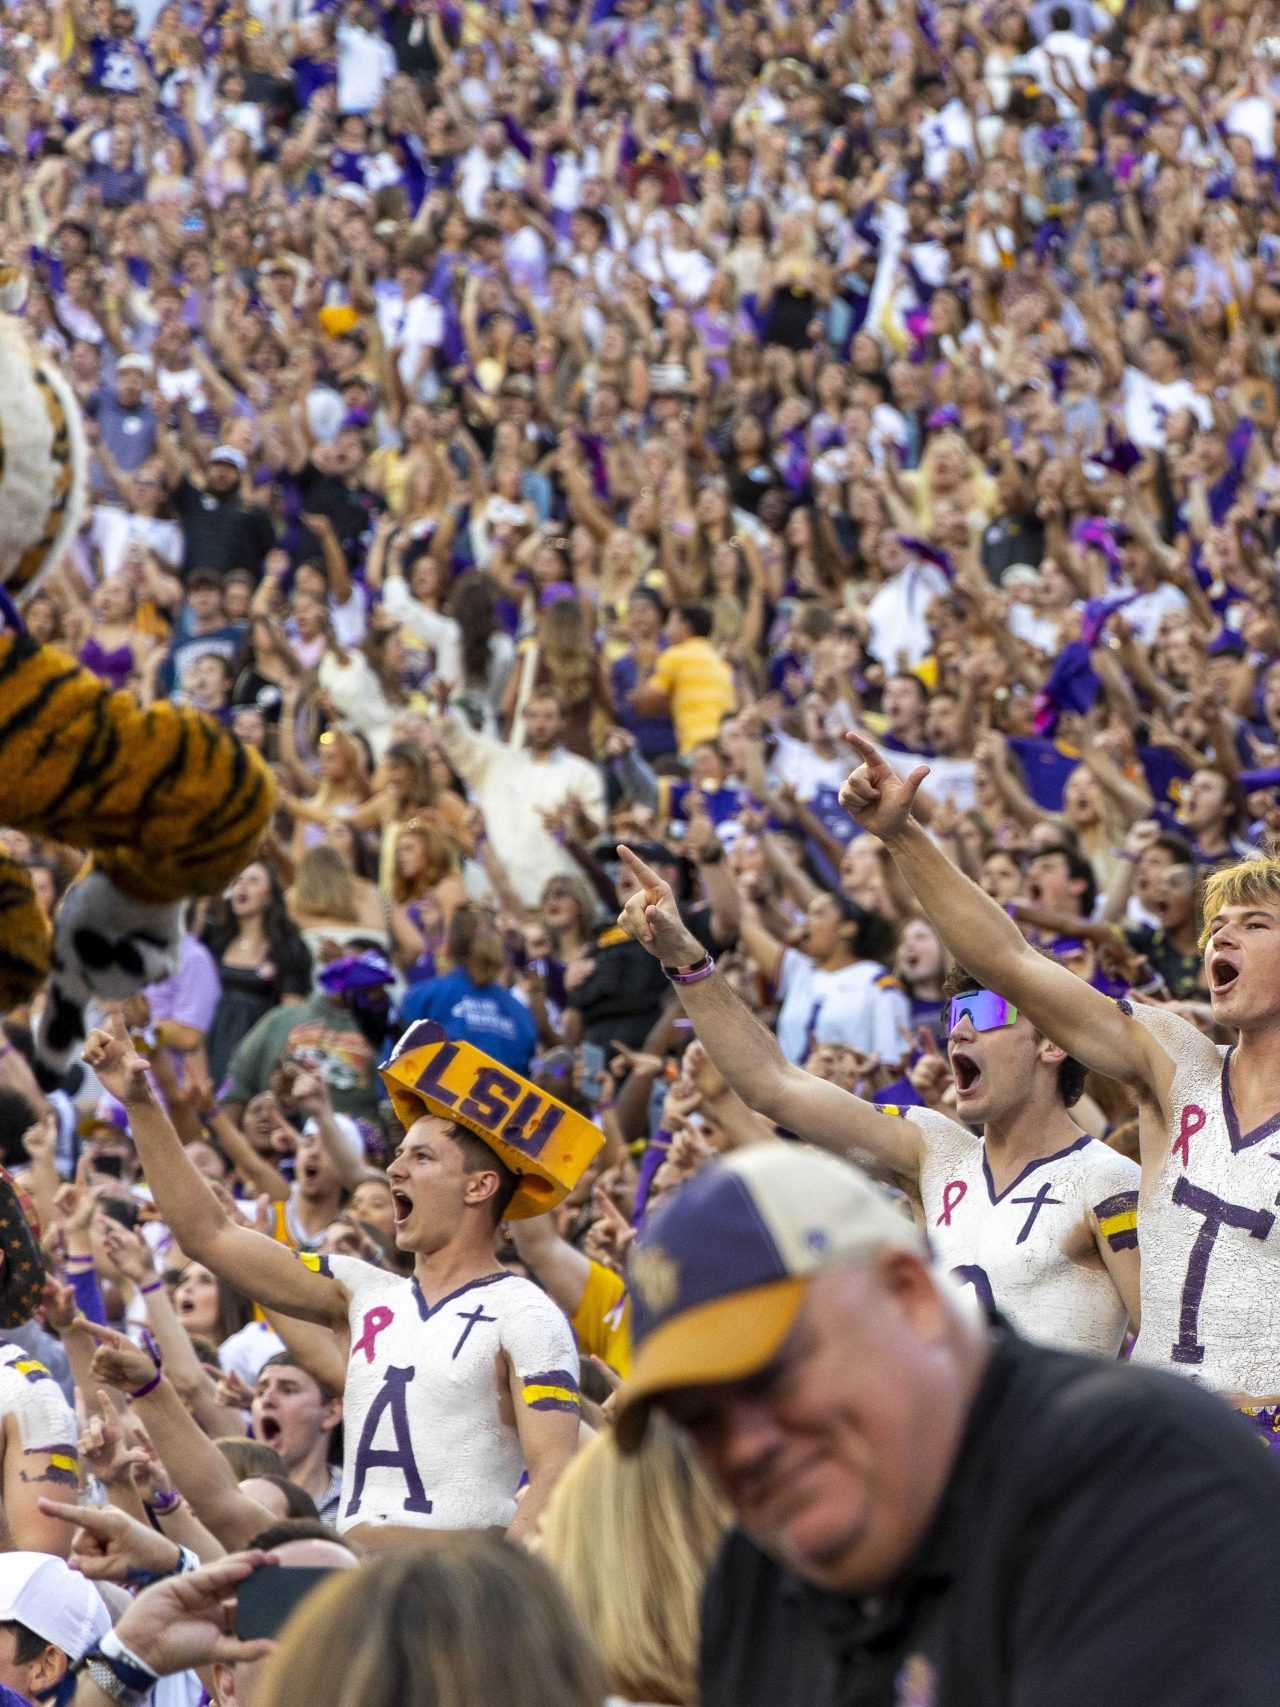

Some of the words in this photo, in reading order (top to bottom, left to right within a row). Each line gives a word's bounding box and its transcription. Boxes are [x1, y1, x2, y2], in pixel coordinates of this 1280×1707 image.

[415, 1042, 565, 1158] LSU
[1171, 1175, 1276, 1365] T
[345, 1365, 433, 1518] A
